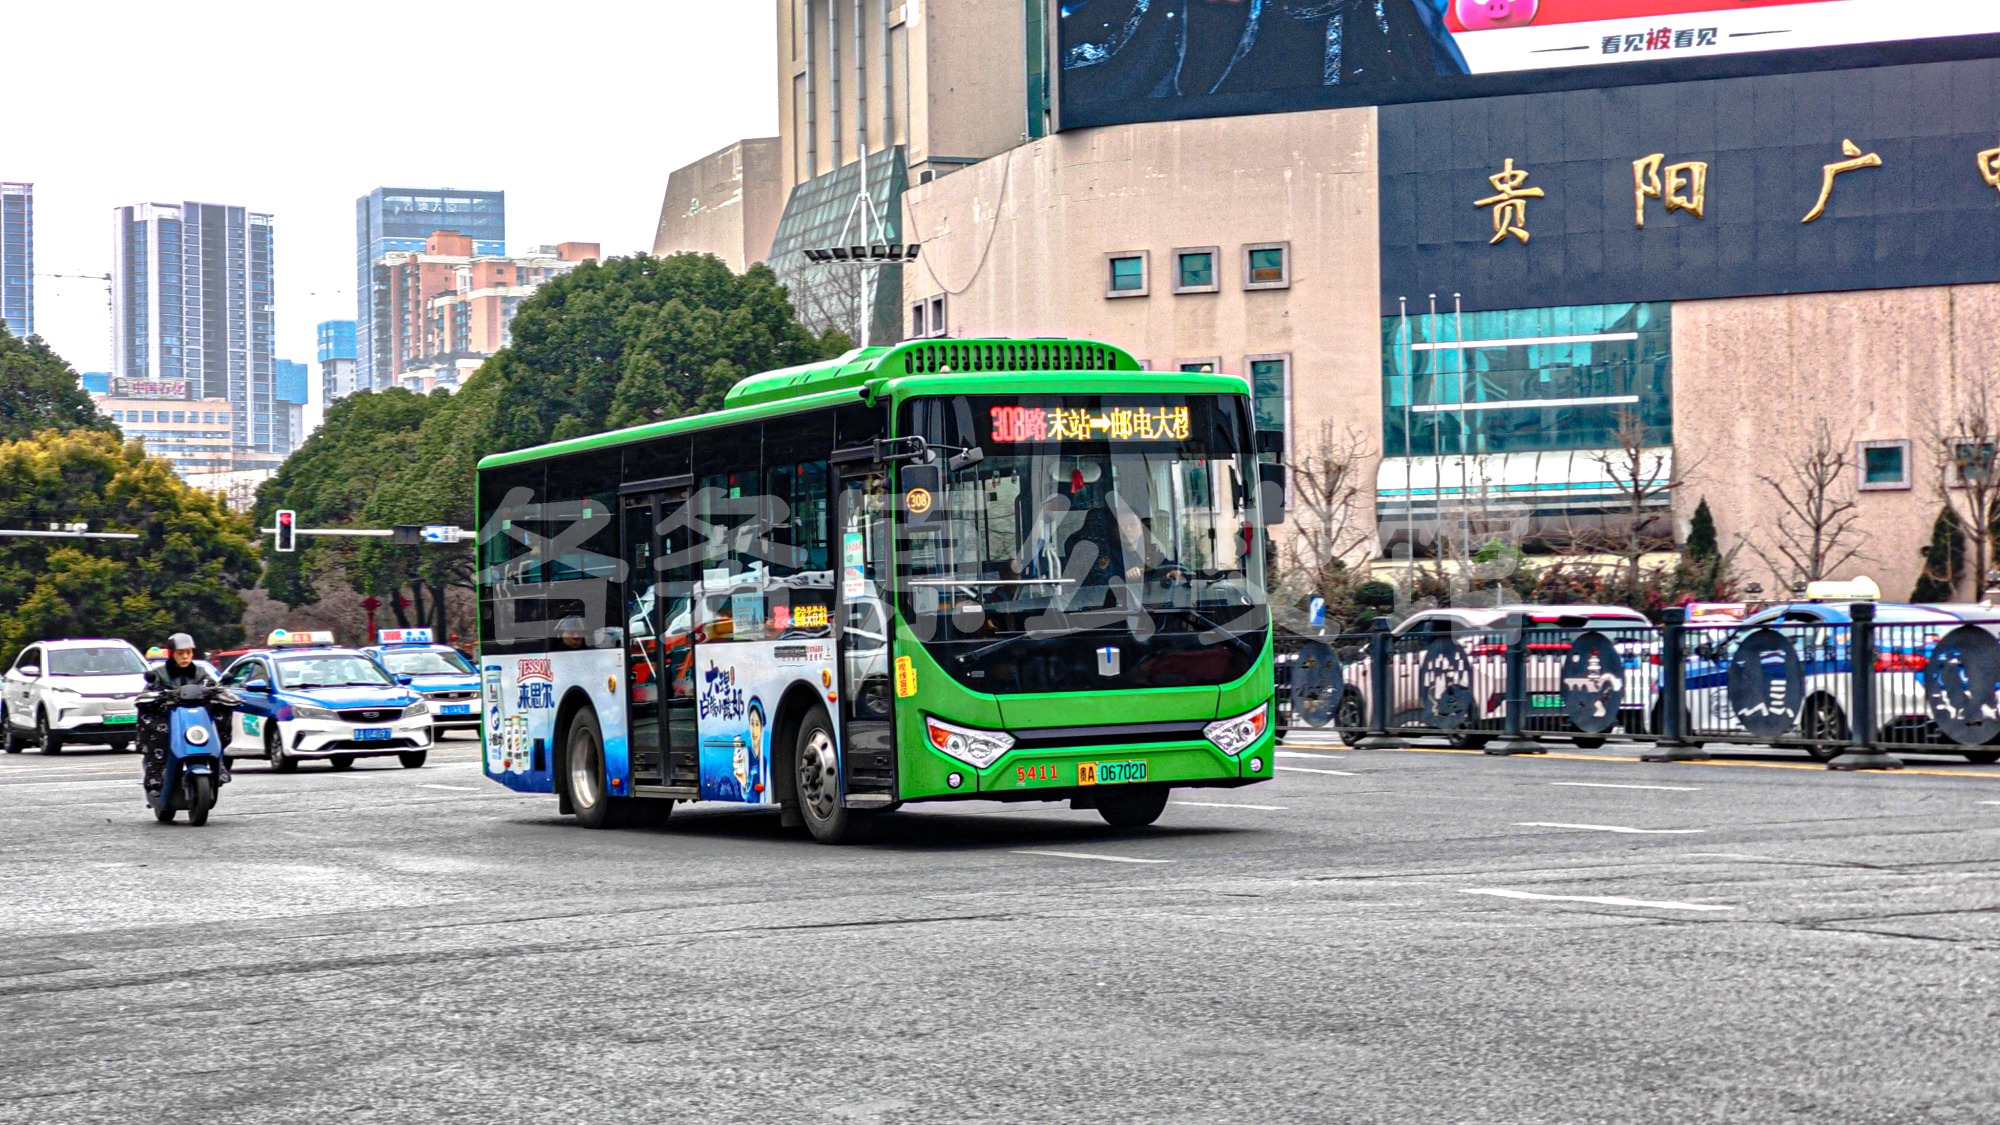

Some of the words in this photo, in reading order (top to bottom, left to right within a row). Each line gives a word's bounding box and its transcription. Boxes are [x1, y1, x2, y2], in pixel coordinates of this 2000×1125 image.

[1601, 27, 1718, 55] 看见被看见
[990, 405, 1048, 442] 308路
[910, 494, 928, 508] 308
[517, 682, 555, 709] 来思尔
[1016, 764, 1058, 782] 5411
